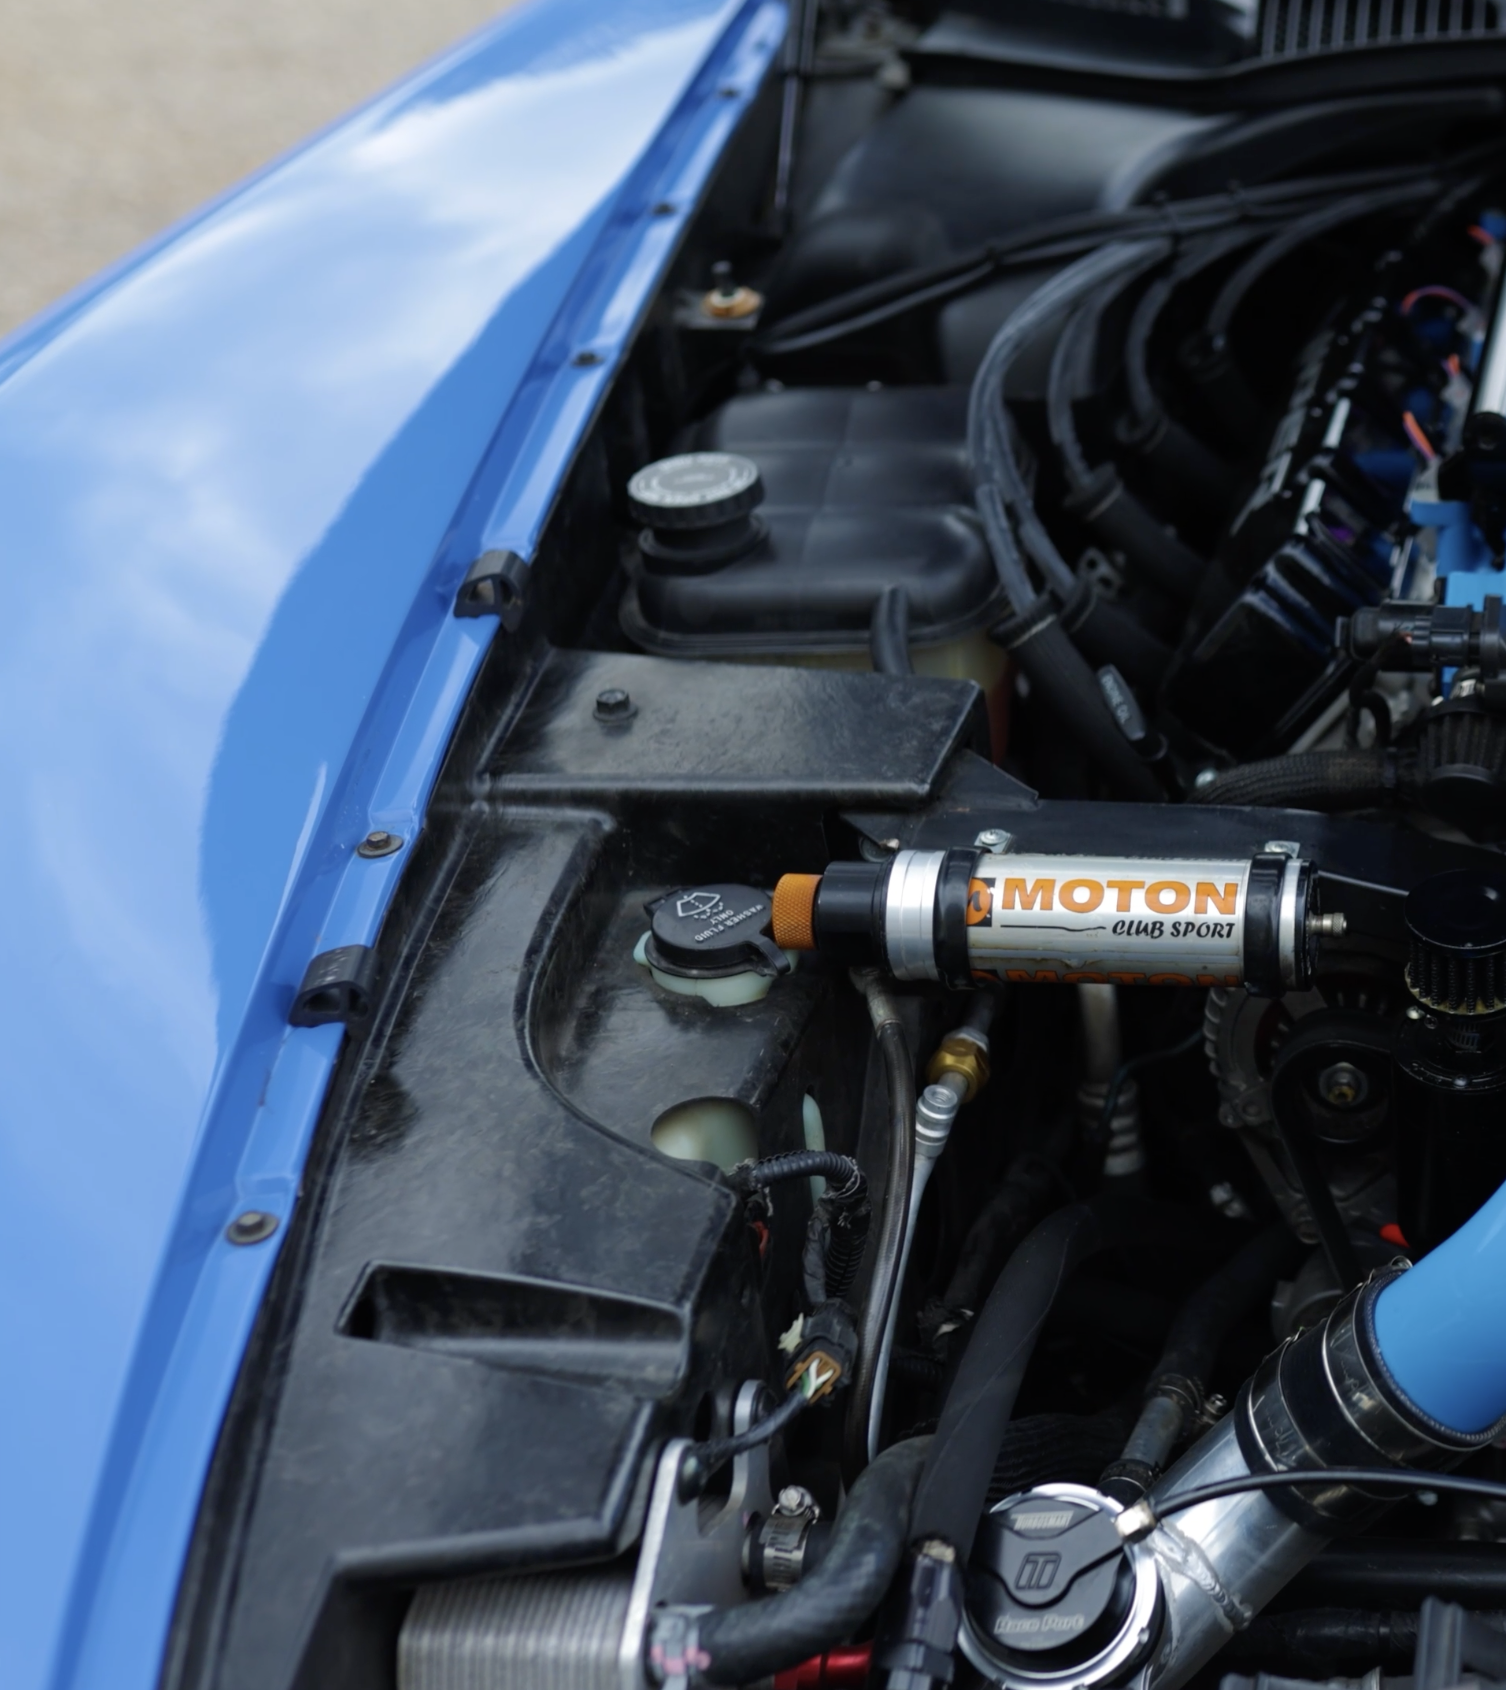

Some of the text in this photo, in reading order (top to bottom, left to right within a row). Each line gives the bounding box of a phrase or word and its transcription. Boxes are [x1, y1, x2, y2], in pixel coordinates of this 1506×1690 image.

[1002, 878, 1239, 915] MOTON
[694, 904, 764, 941] WASHER FLUID
[710, 909, 734, 925] ONLY
[1112, 920, 1235, 939] CLUB SPORT
